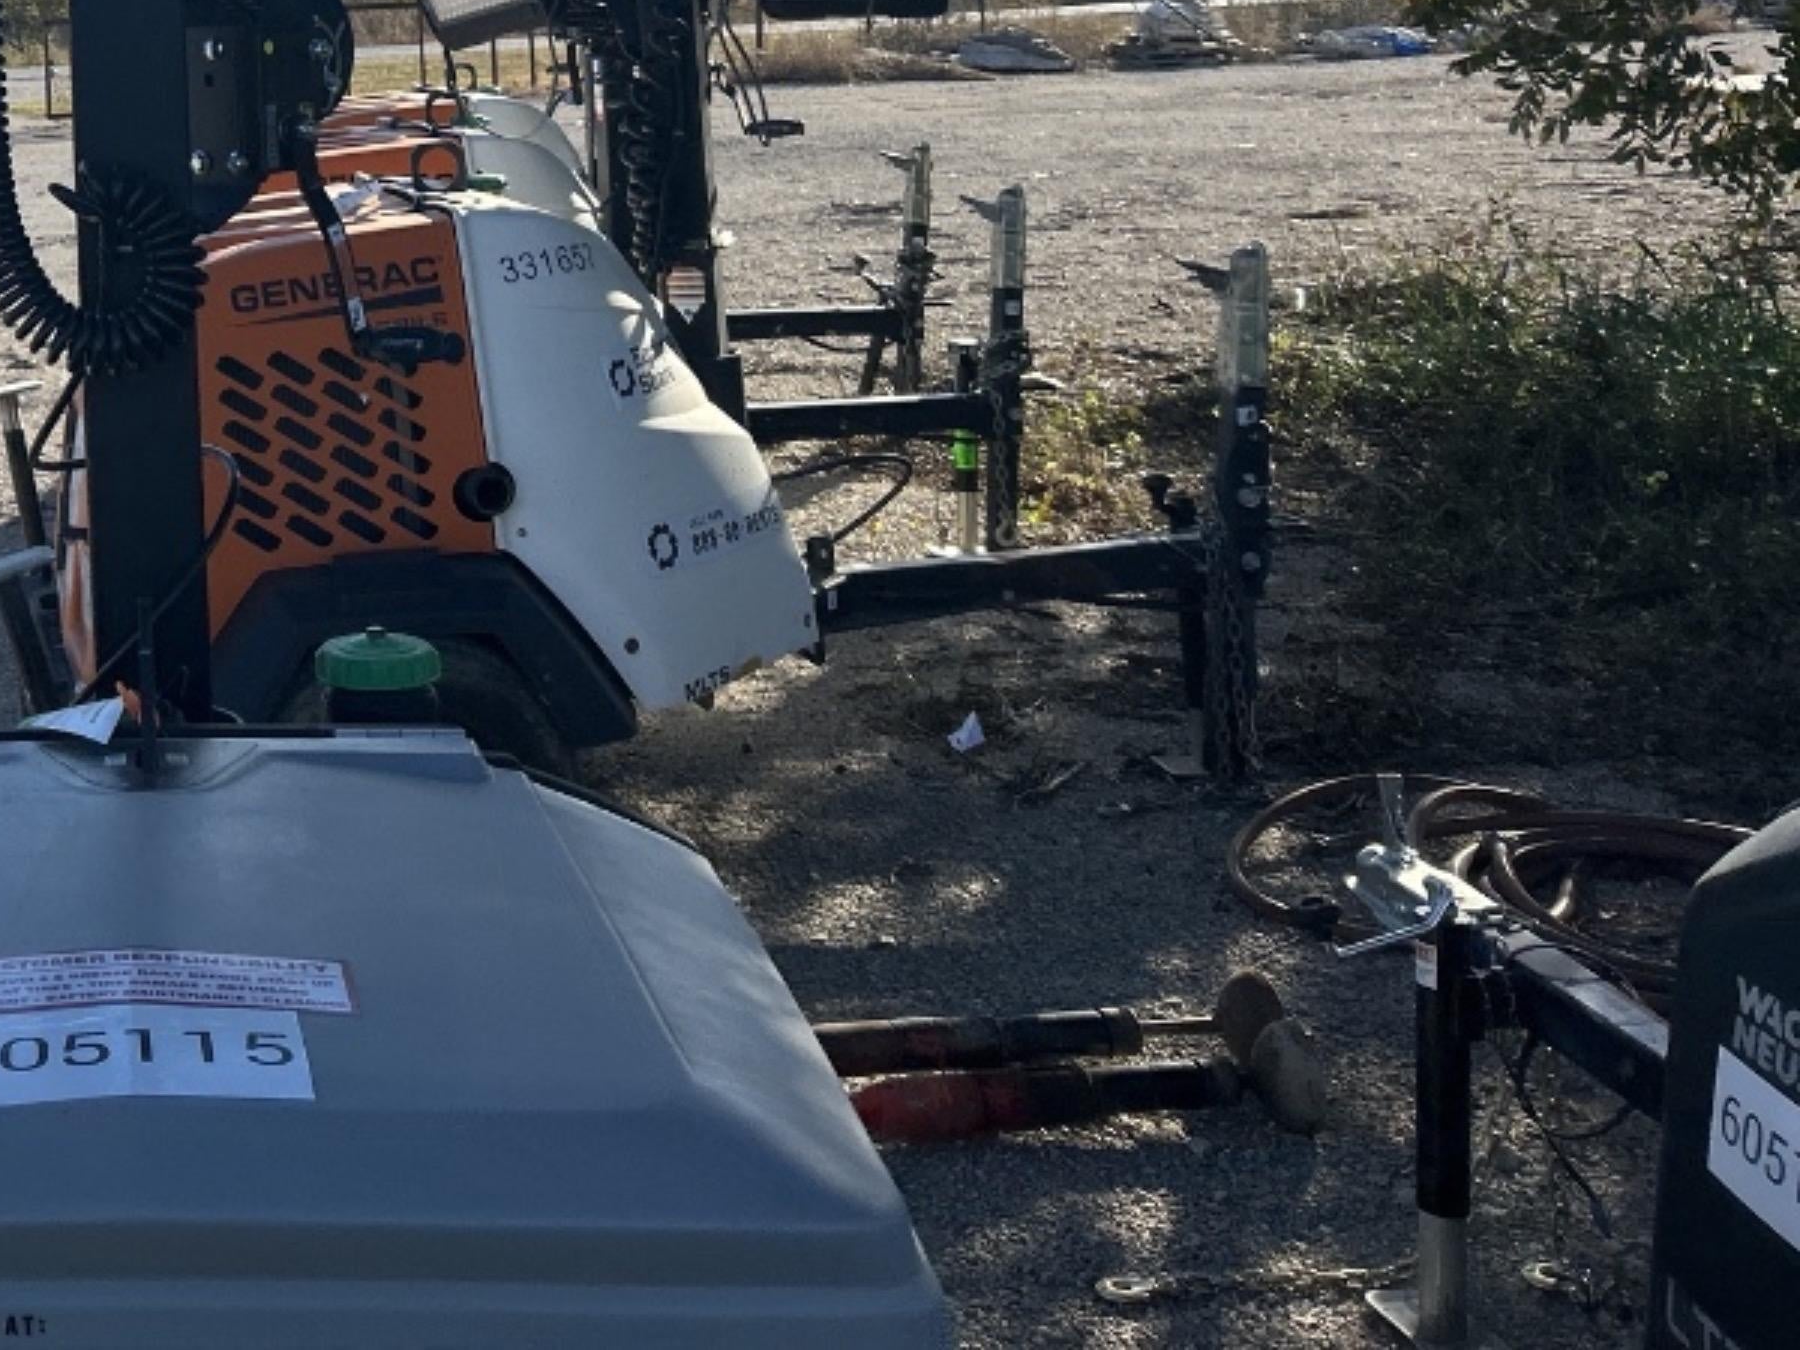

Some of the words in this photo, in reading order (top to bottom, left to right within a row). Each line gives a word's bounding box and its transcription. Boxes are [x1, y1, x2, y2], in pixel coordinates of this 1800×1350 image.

[230, 256, 440, 313] GENERAC
[1731, 1014, 1800, 1093] NEU
[1720, 1096, 1800, 1203] 605
[5, 1314, 47, 1336] AT:
